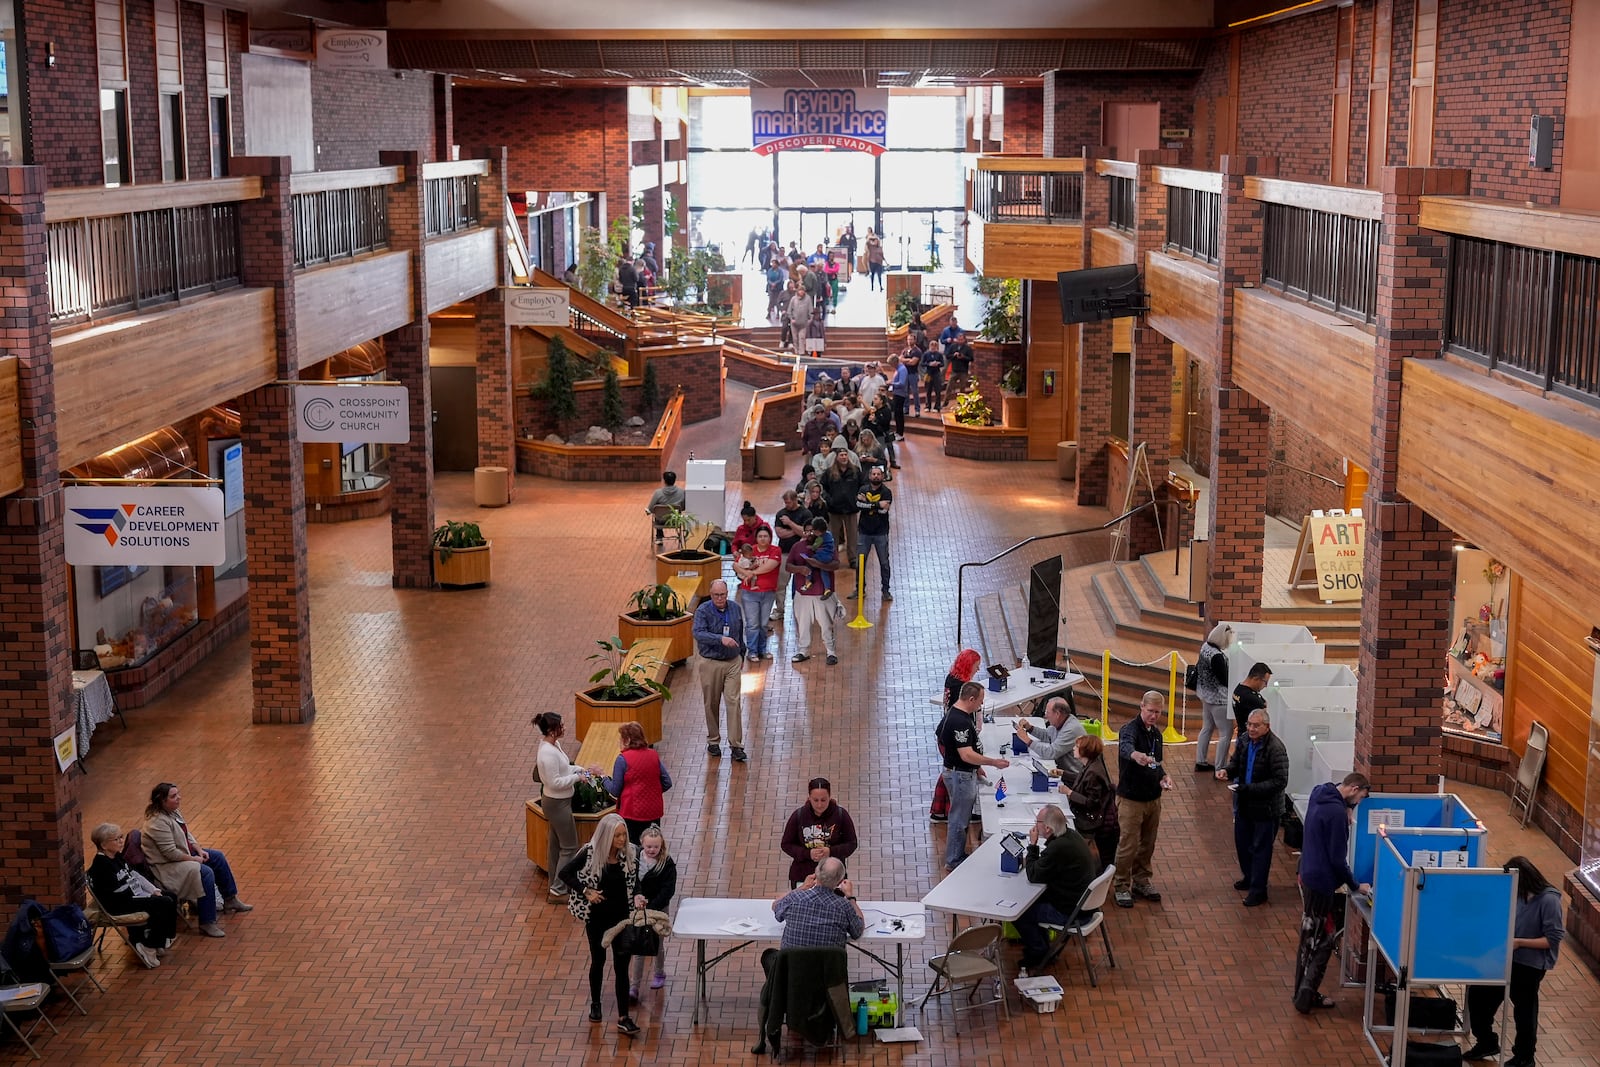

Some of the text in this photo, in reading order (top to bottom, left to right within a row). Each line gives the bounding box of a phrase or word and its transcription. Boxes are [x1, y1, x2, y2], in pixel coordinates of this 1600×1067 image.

[330, 37, 374, 49] EmployNV
[785, 90, 855, 112] NEVADA
[754, 112, 885, 134] MARKETPLACE
[766, 136, 873, 153] DISCOVER NEVADA
[518, 296, 558, 307] EmployNV
[339, 398, 401, 407] CROSSPOINT
[339, 410, 399, 419] COMMUNITY
[340, 422, 380, 431] CHURCH
[137, 506, 185, 517] CAREER
[129, 521, 220, 532] DEVELOPMENT
[1320, 522, 1363, 545] ART
[120, 536, 190, 547] SOLUTIONS
[1336, 549, 1356, 557] AND
[1323, 573, 1363, 590] SHO
